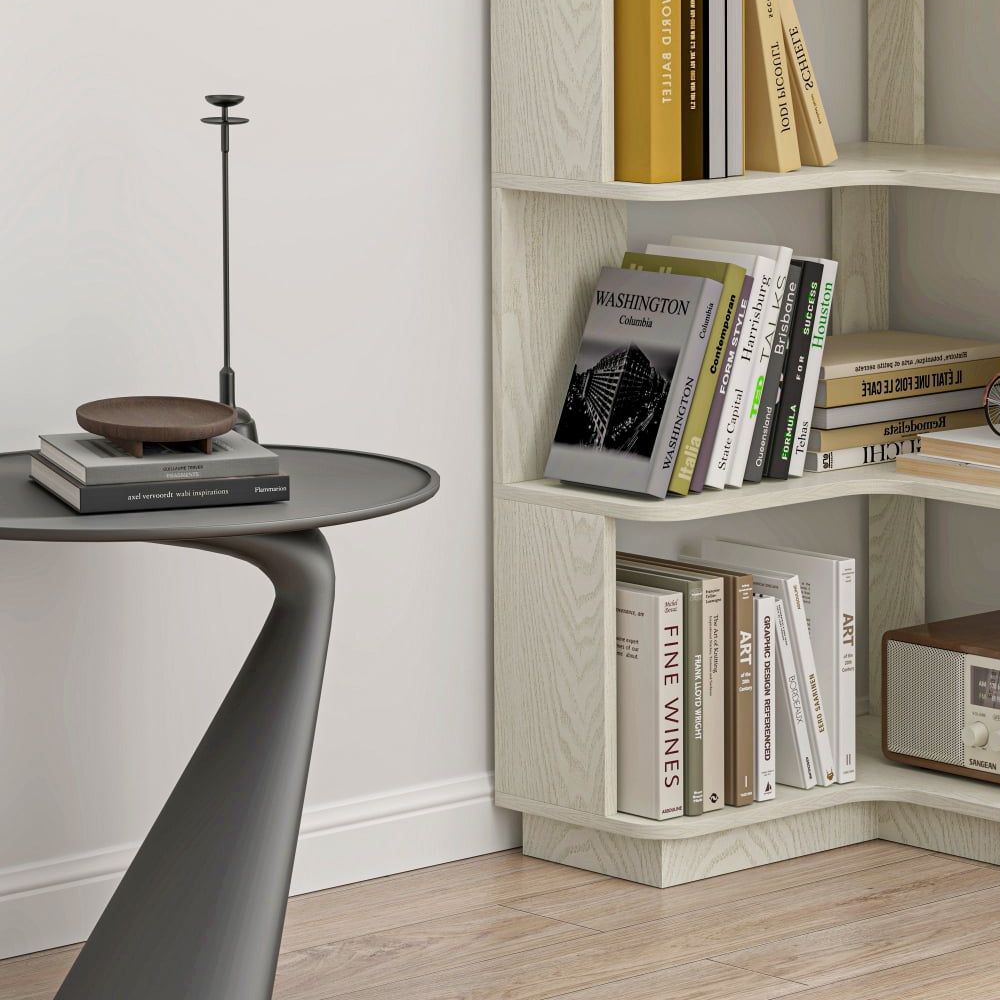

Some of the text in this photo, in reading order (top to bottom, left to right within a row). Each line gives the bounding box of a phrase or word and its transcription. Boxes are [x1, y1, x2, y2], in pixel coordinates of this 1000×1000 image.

[595, 290, 691, 316] WASHINGTON
[619, 315, 653, 328] Columbia
[774, 281, 797, 355] Brisbane
[812, 282, 833, 350] Houston
[719, 298, 749, 395] FORM STYLE
[662, 302, 714, 470] WASHINGTON Columbia
[718, 274, 772, 470] State Capital Harrisburg
[781, 282, 818, 460] FORMULA FOR SUCCESS
[750, 375, 765, 420] TED
[678, 436, 702, 482] Italia
[127, 491, 173, 501] axel vervoordt
[192, 488, 229, 498] inspirations
[739, 630, 752, 666] ART
[842, 613, 854, 647] ART
[664, 625, 680, 789] FINE WINES
[969, 758, 997, 770] SANGEAN
